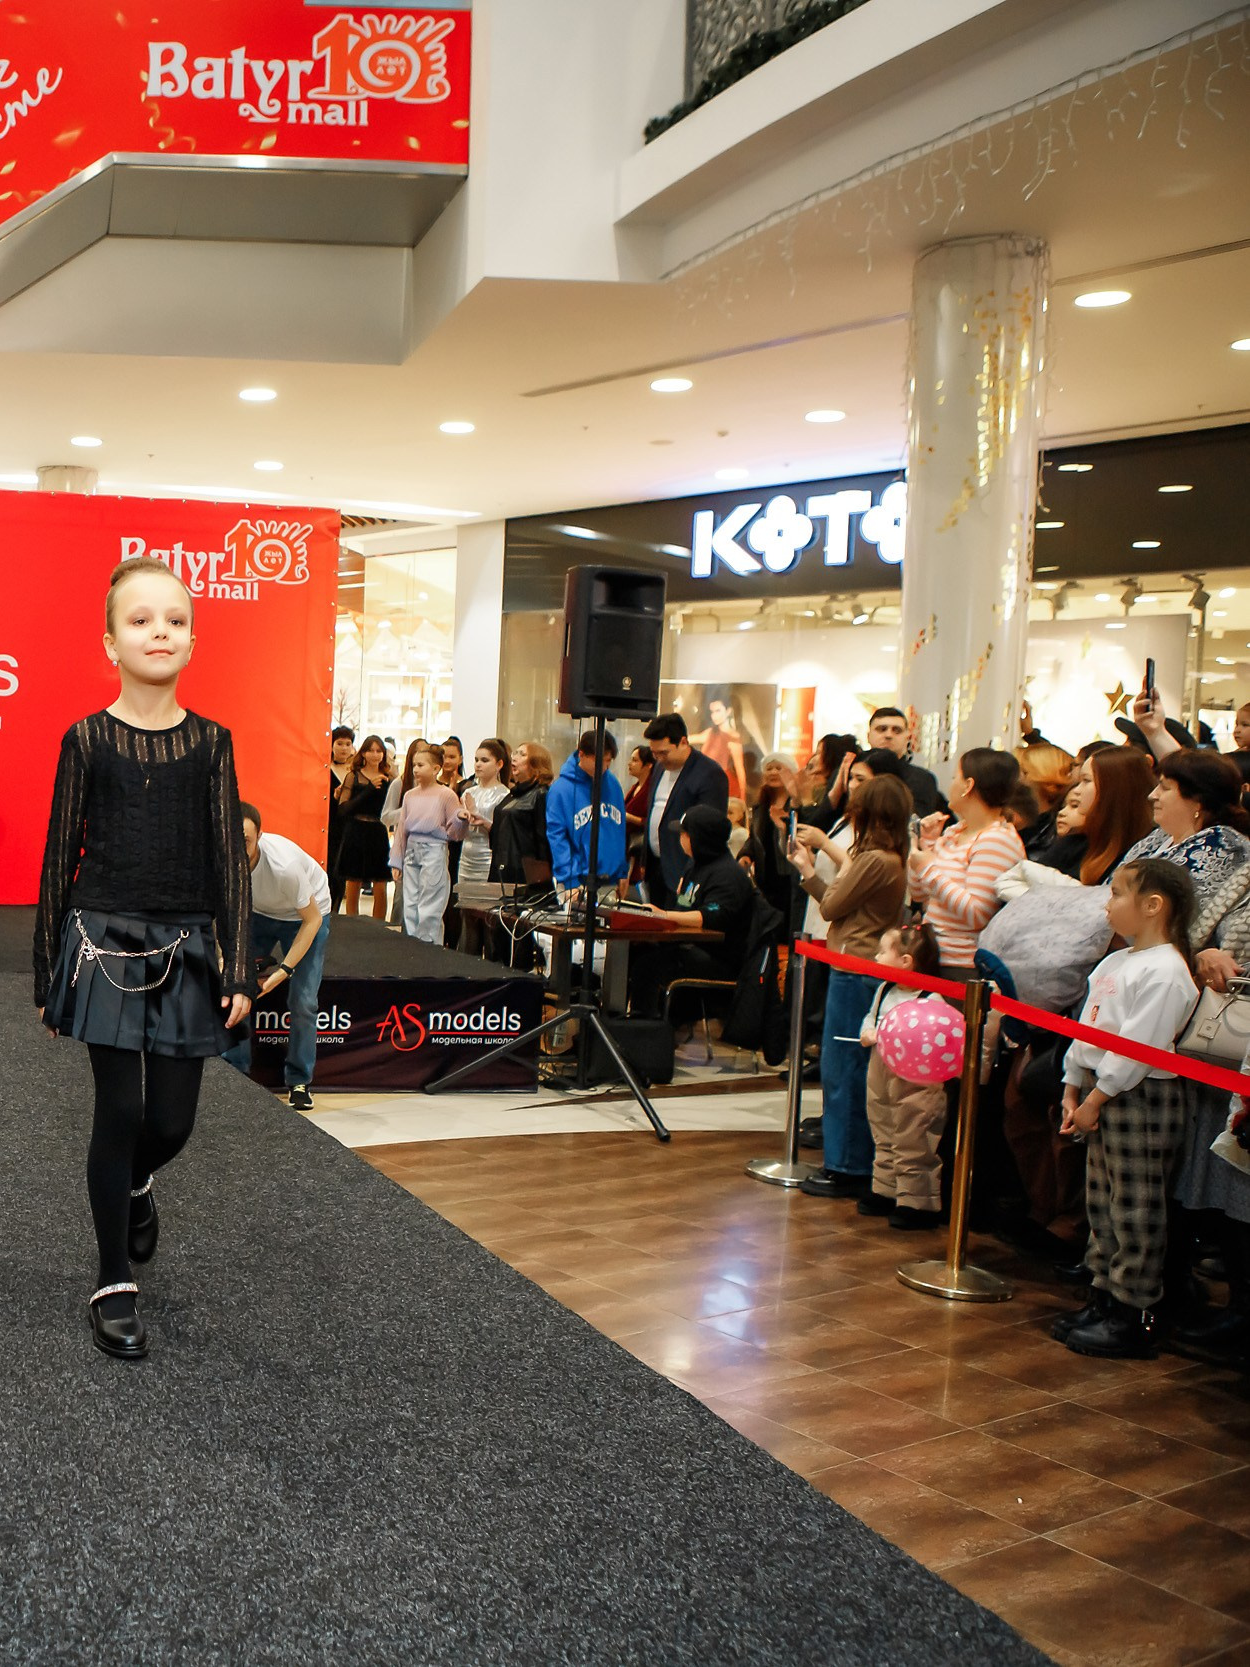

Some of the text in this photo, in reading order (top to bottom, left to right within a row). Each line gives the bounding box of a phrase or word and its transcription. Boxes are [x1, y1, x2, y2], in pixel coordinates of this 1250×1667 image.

[146, 41, 314, 123] Batyr
[287, 100, 369, 126] mall
[209, 582, 259, 600] mall
[255, 1005, 352, 1030] moels
[376, 1003, 521, 1052] AS models
[431, 1037, 483, 1046] модельная
